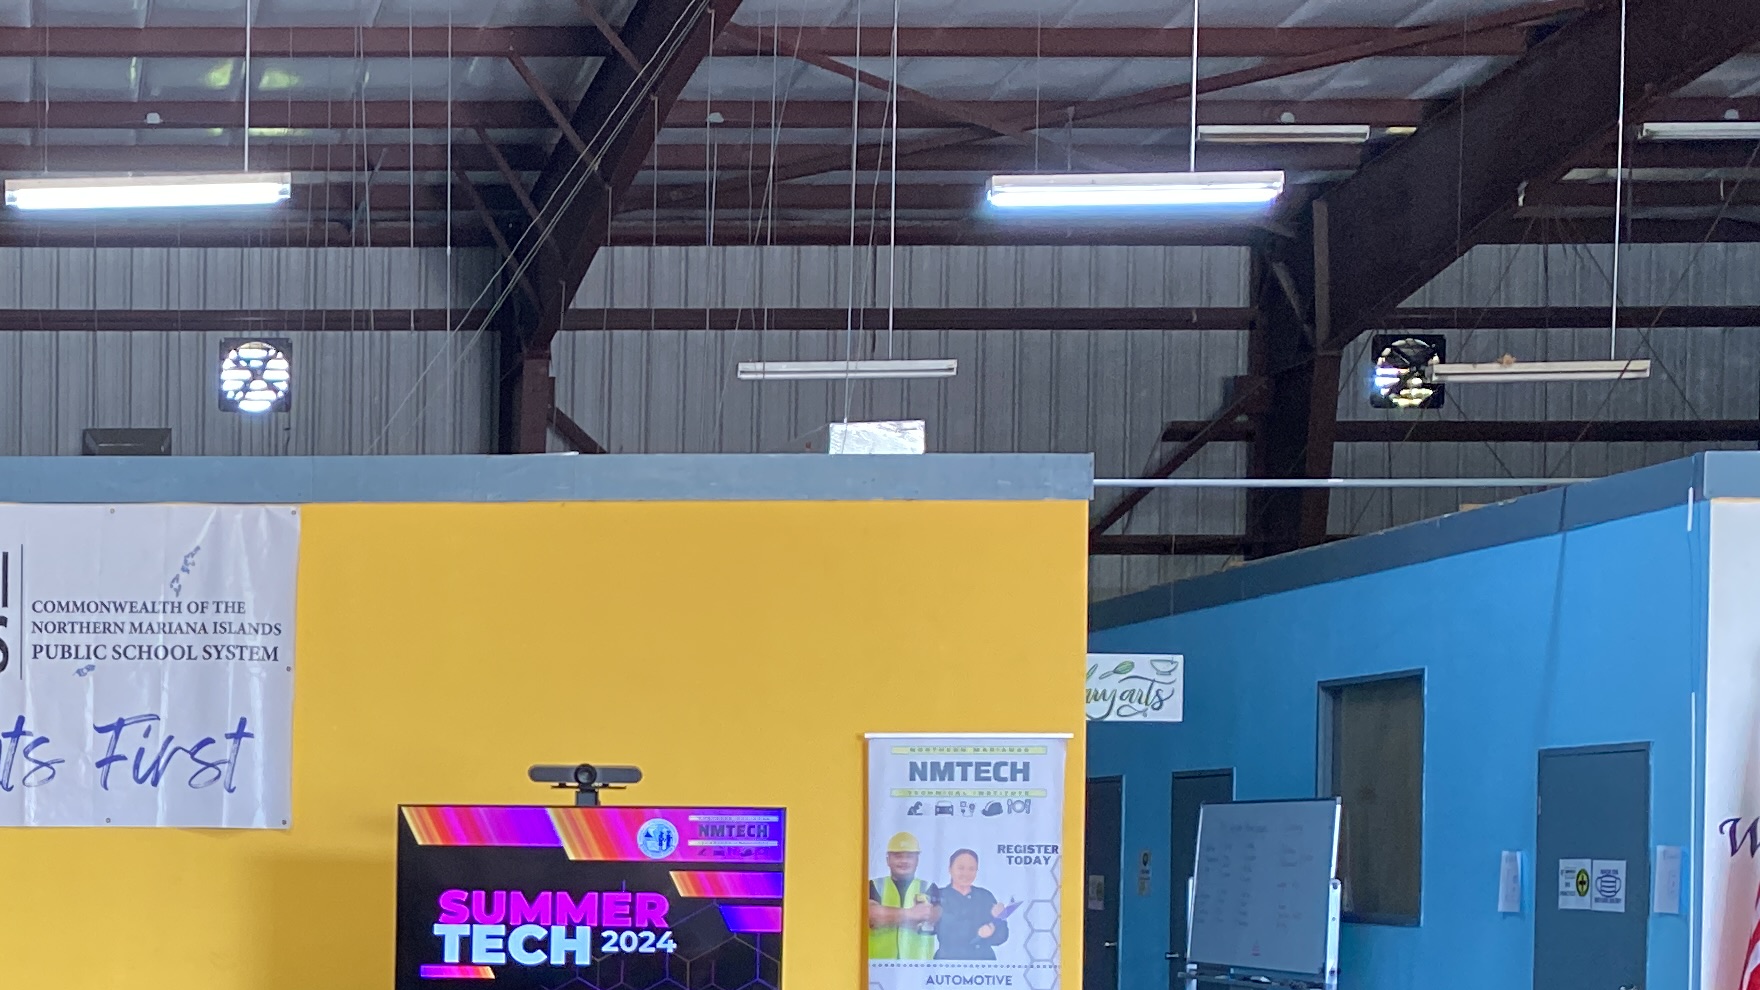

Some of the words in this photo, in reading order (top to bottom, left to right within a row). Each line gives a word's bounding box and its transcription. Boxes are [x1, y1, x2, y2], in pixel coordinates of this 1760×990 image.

[31, 600, 183, 614] COMMONWEALTH
[186, 601, 209, 614] OF
[212, 601, 246, 614] THE
[31, 621, 125, 635] NORTHERN
[128, 621, 208, 635] MARIANA
[212, 621, 282, 636] ISLANDS
[31, 644, 107, 660] PUBLIC
[111, 644, 198, 660] SCHOOL
[201, 644, 279, 661] SYSTEM
[93, 713, 254, 793] First
[909, 761, 1030, 782] NMTECH
[698, 824, 769, 837] NMTECH
[997, 845, 1059, 854] REGISTER
[1006, 855, 1051, 865] TODAY
[438, 889, 670, 928] SUMMER
[433, 923, 591, 965] TECH
[601, 930, 677, 953] 2024
[926, 974, 1013, 986] AUTOMOTIVE
